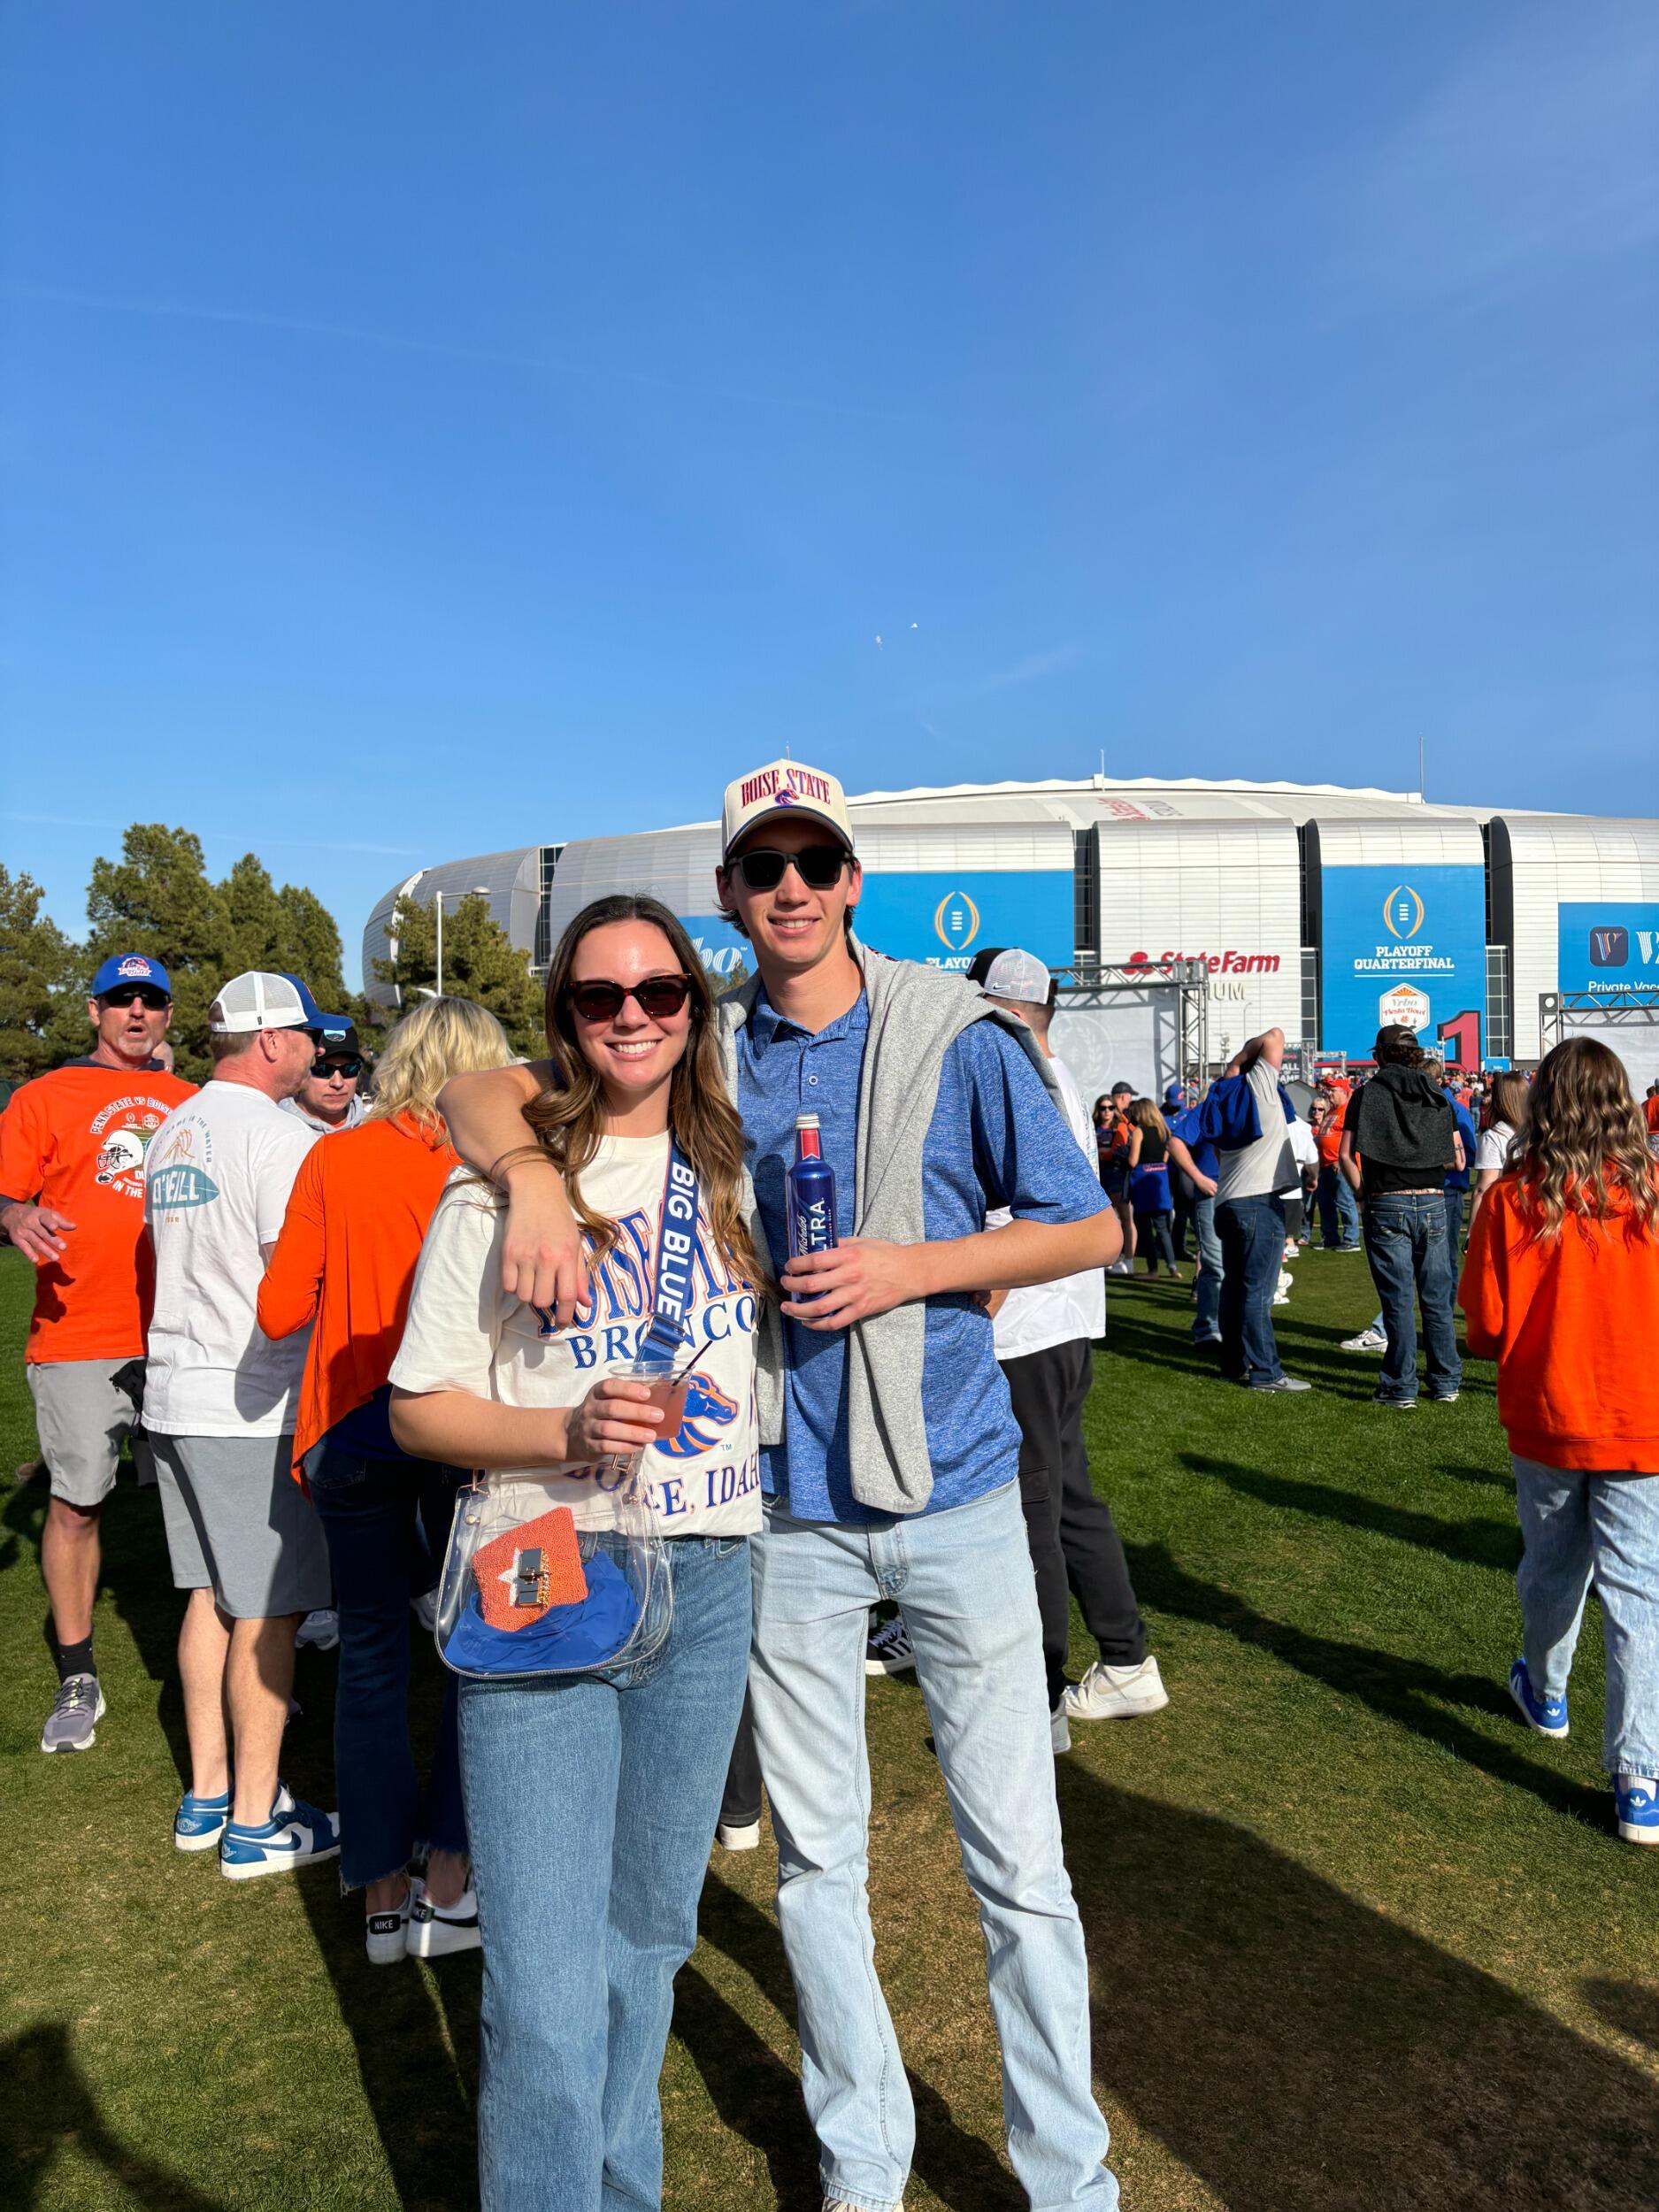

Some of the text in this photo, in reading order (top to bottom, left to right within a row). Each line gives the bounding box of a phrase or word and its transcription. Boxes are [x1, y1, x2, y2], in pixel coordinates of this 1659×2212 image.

[741, 768, 831, 809] BOISE STATE
[926, 957, 972, 969] PLAYO
[1160, 950, 1280, 974] SeFarm
[1375, 945, 1433, 957] PLAYOFF
[1354, 957, 1455, 970] QUARTERFINAL
[1587, 980, 1631, 991] Private
[90, 1111, 109, 1134] PENN
[105, 1097, 134, 1117] STATE
[134, 1096, 146, 1105] VS
[111, 1179, 125, 1193] IN
[125, 1186, 144, 1199] THE
[796, 1210, 809, 1256] Michelob
[810, 1200, 827, 1251] TRA
[657, 1161, 695, 1321] BIG BLUE
[705, 1449, 759, 1509] IDAH
[374, 1919, 394, 1930] NIKE
